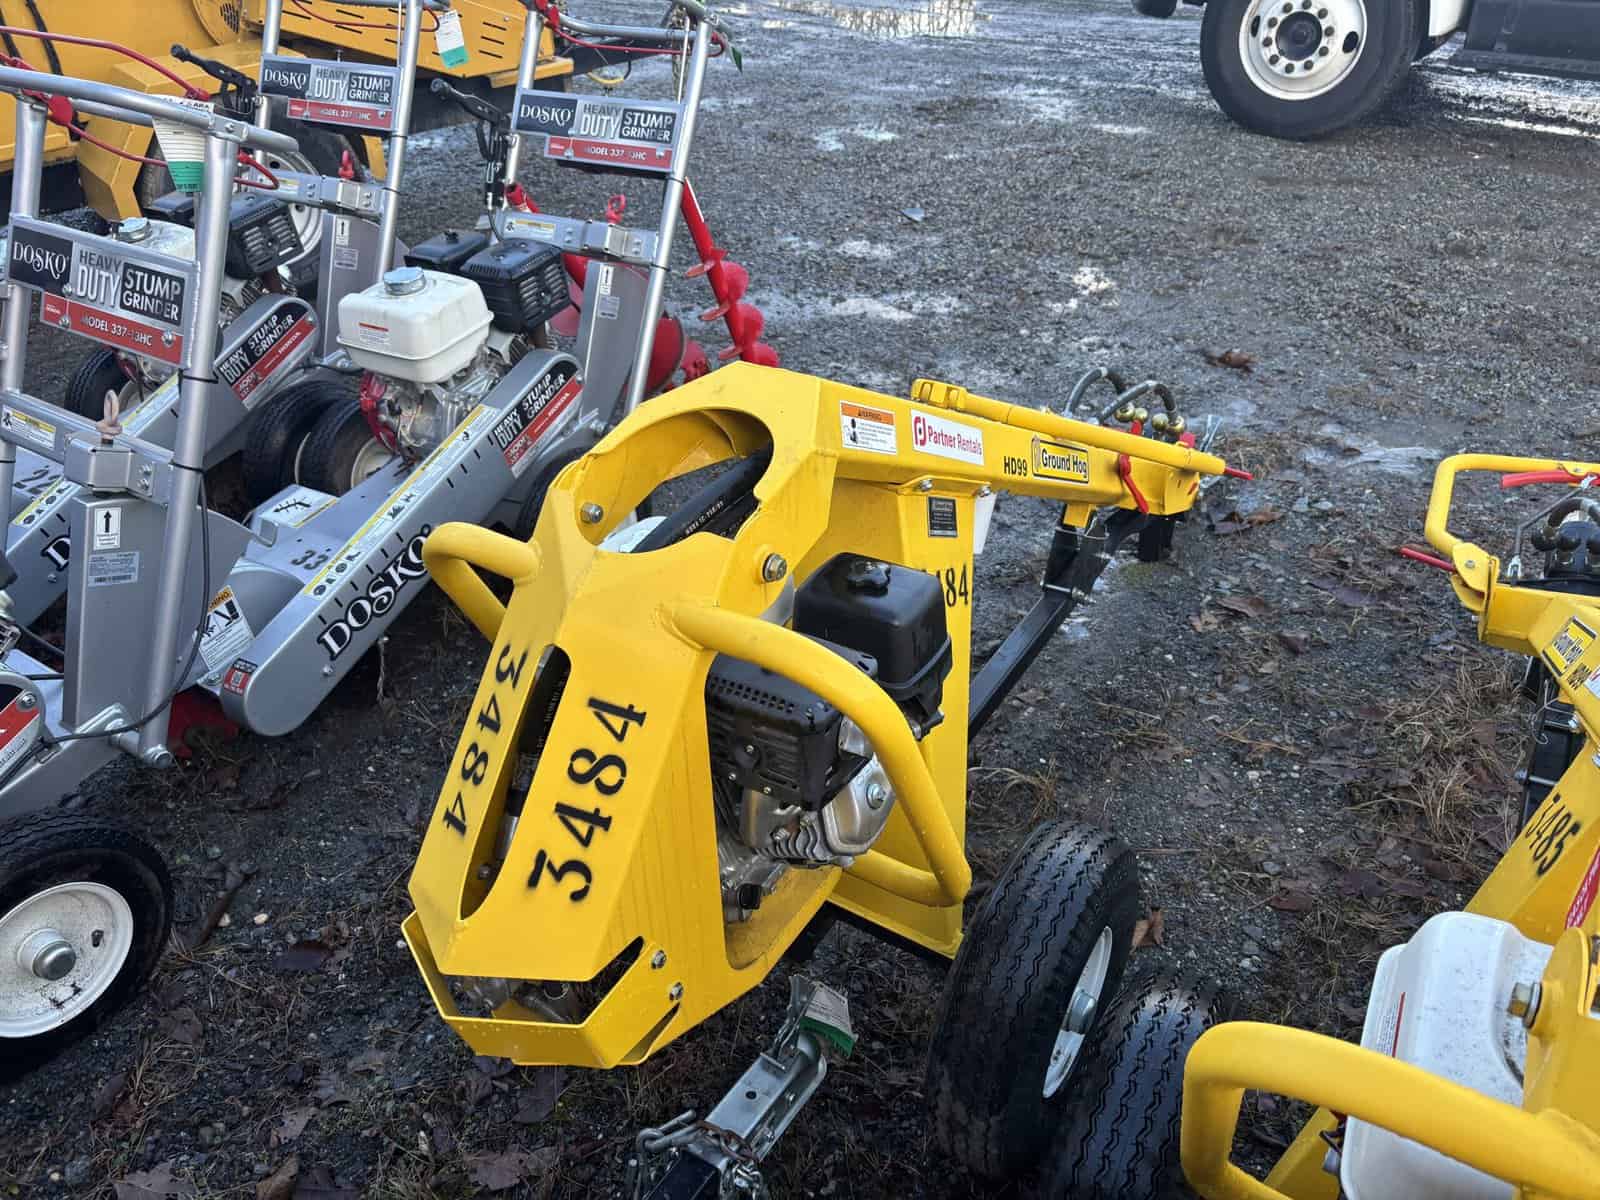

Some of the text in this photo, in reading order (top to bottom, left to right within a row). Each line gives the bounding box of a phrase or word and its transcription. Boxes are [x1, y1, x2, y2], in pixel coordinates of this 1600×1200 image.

[264, 68, 306, 90] DOSKO
[316, 67, 348, 79] HEAVY
[350, 75, 391, 92] STUMP
[314, 78, 348, 101] DUTY
[348, 89, 391, 103] GRINDER
[520, 103, 571, 127] DOSKO
[583, 103, 622, 115] HEAVY
[624, 111, 673, 129] STUMP
[580, 113, 622, 139] DUTY
[621, 126, 671, 143] GRINDER
[12, 240, 67, 280] DOSKO
[79, 249, 122, 273] HEAVY
[77, 264, 121, 308] DUTY
[125, 268, 182, 301] STUMP
[122, 291, 179, 321] GRINDER
[247, 314, 279, 349] STUMP
[254, 313, 295, 357] GRINDER
[219, 346, 244, 373] HEAVY
[224, 351, 252, 384] DUTY
[521, 373, 552, 411] STUMP
[527, 373, 566, 419] GRINDER
[493, 407, 519, 436] HEAVY
[495, 416, 523, 449] DUTY
[927, 425, 983, 456] Partner Rentals
[1003, 455, 1028, 477] HD99
[1041, 448, 1087, 479] Ground Hog
[442, 642, 529, 838] 3484
[526, 696, 648, 903] 3484
